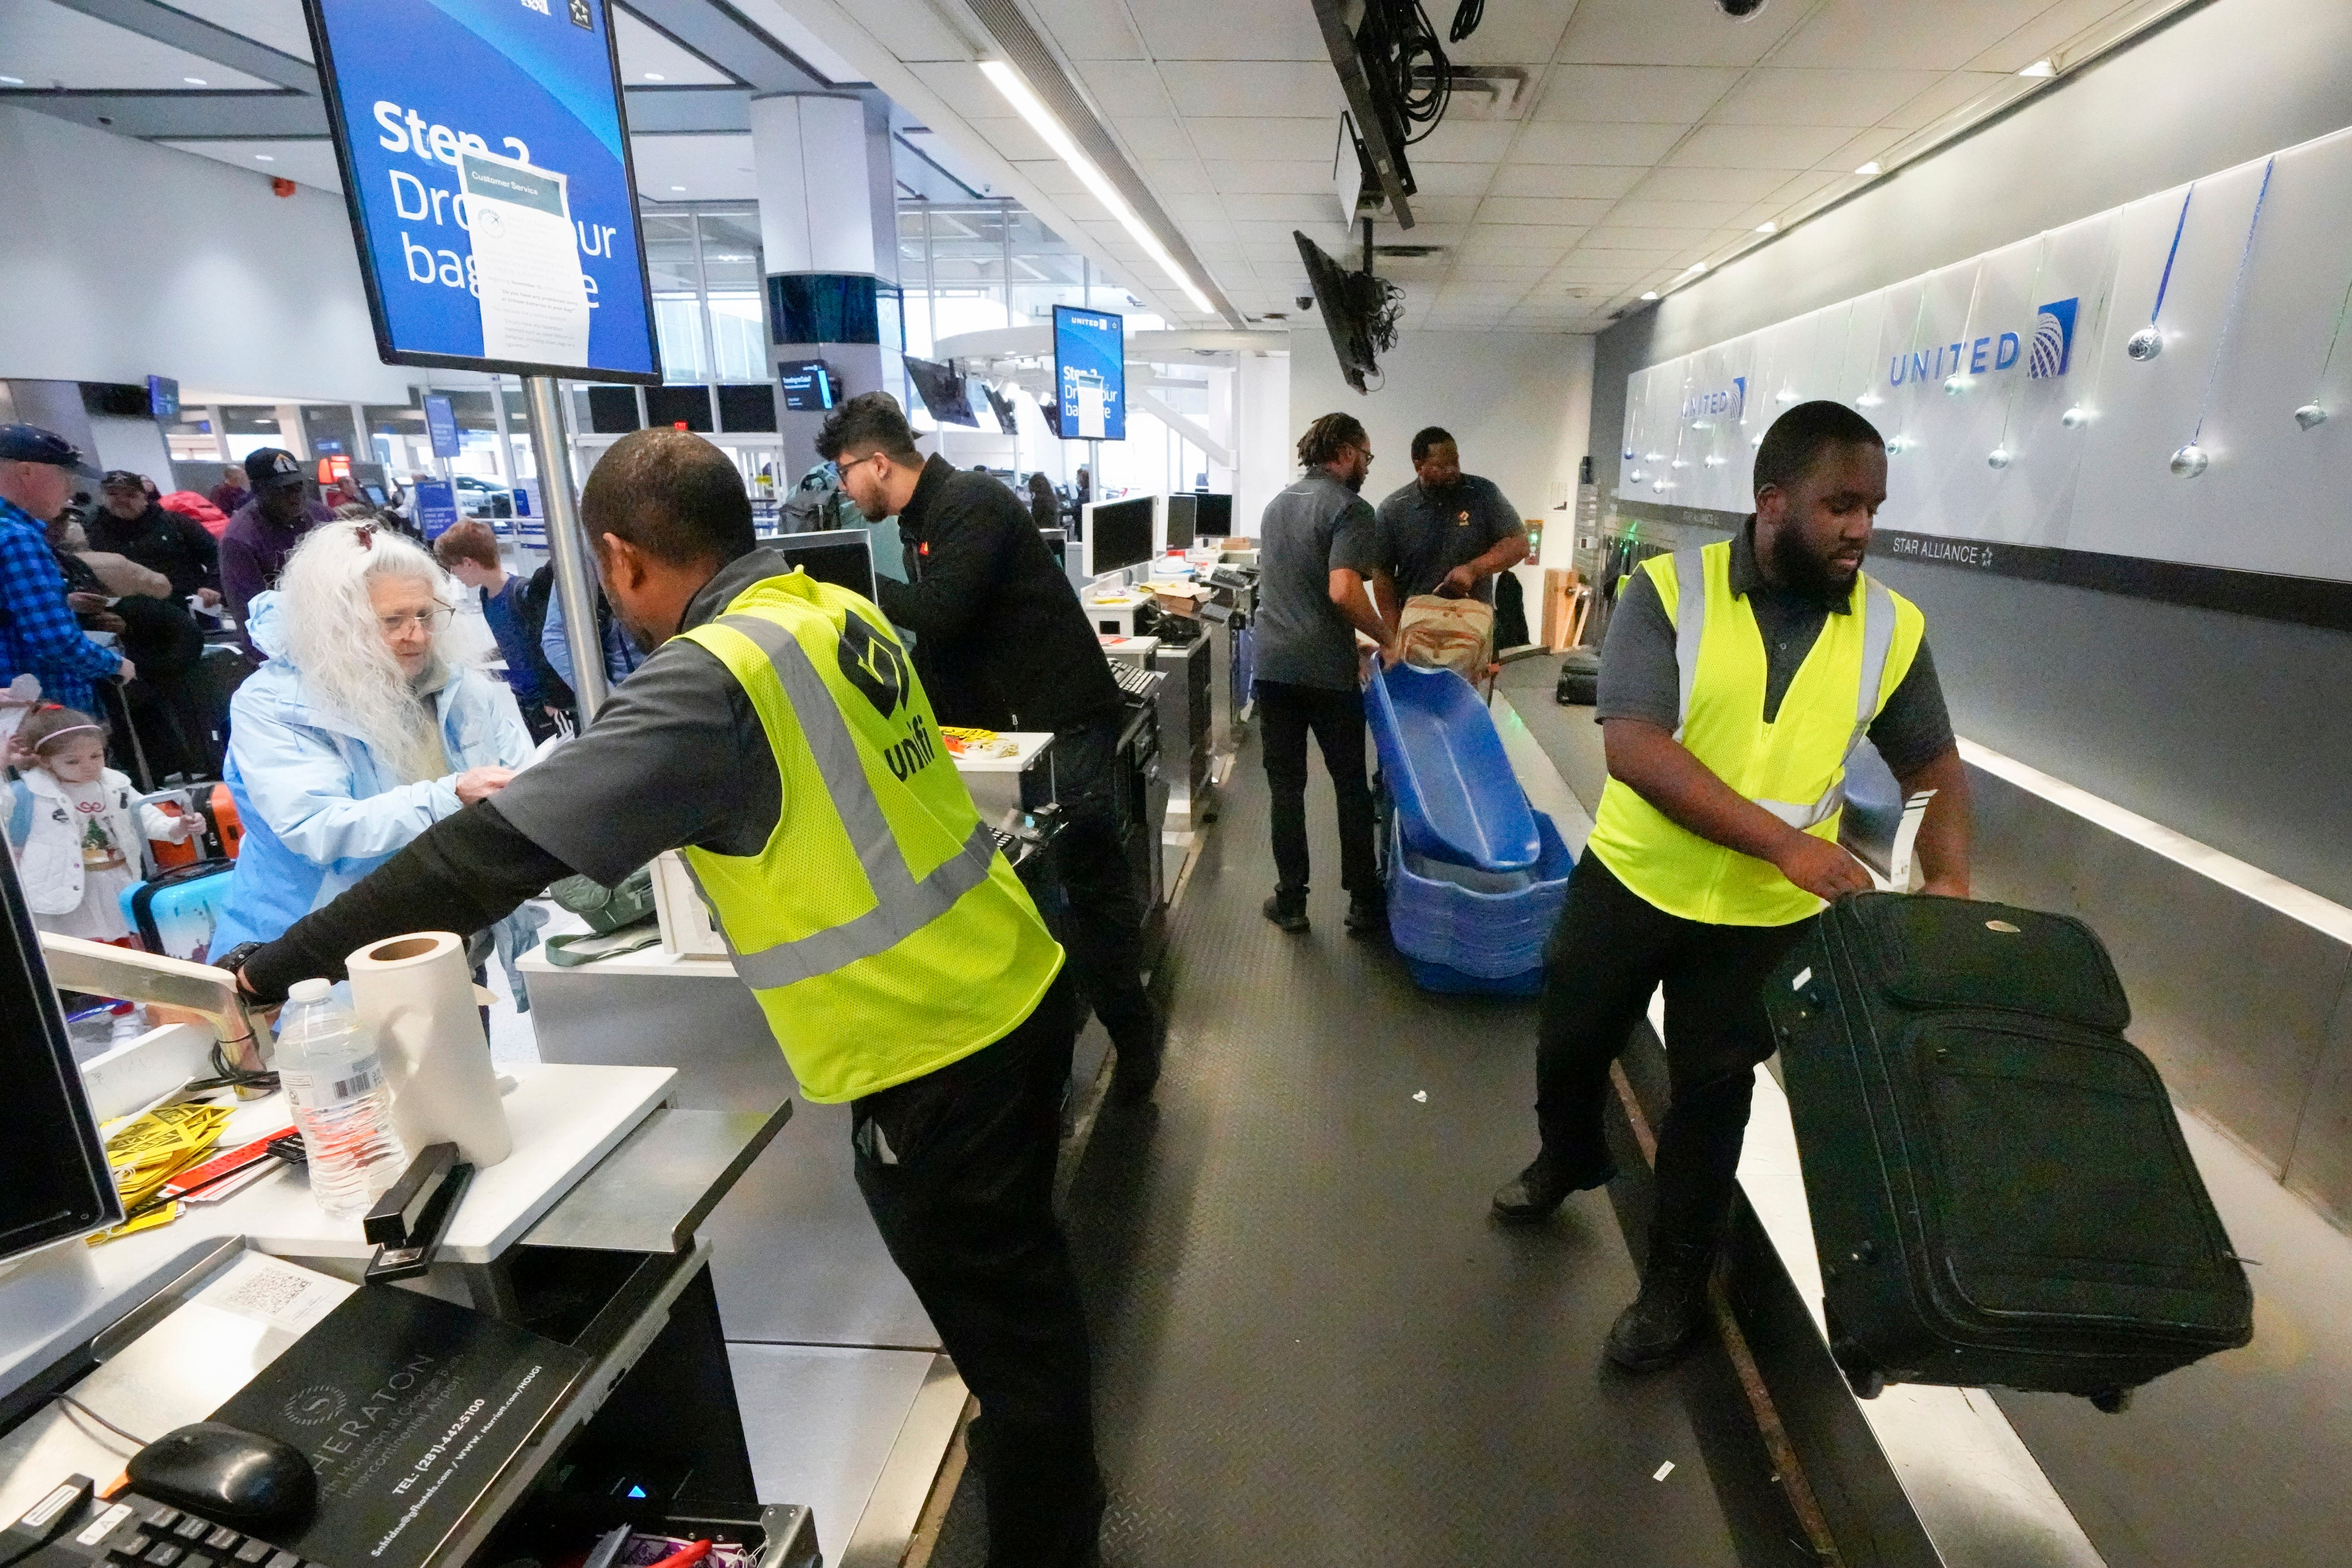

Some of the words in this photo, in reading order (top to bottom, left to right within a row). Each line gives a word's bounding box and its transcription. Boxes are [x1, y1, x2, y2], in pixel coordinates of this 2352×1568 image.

[472, 171, 510, 187] Customer
[511, 182, 539, 195] Service
[389, 170, 469, 231] Dr
[572, 220, 616, 259] ur
[1071, 317, 1099, 327] UNITED
[1890, 332, 2020, 387] UNITED
[1893, 537, 1918, 555] STAR
[1921, 541, 1978, 563] ALLIANCE
[884, 714, 935, 782] unifi
[132, 1132, 179, 1151] HEAVY
[313, 1354, 434, 1475] HERATON
[340, 1413, 429, 1499] Intercontinental
[426, 1375, 464, 1412] Airport
[338, 1430, 390, 1477] Houston
[392, 1473, 419, 1495] TEL:
[414, 1398, 485, 1472] (281)-442-5100
